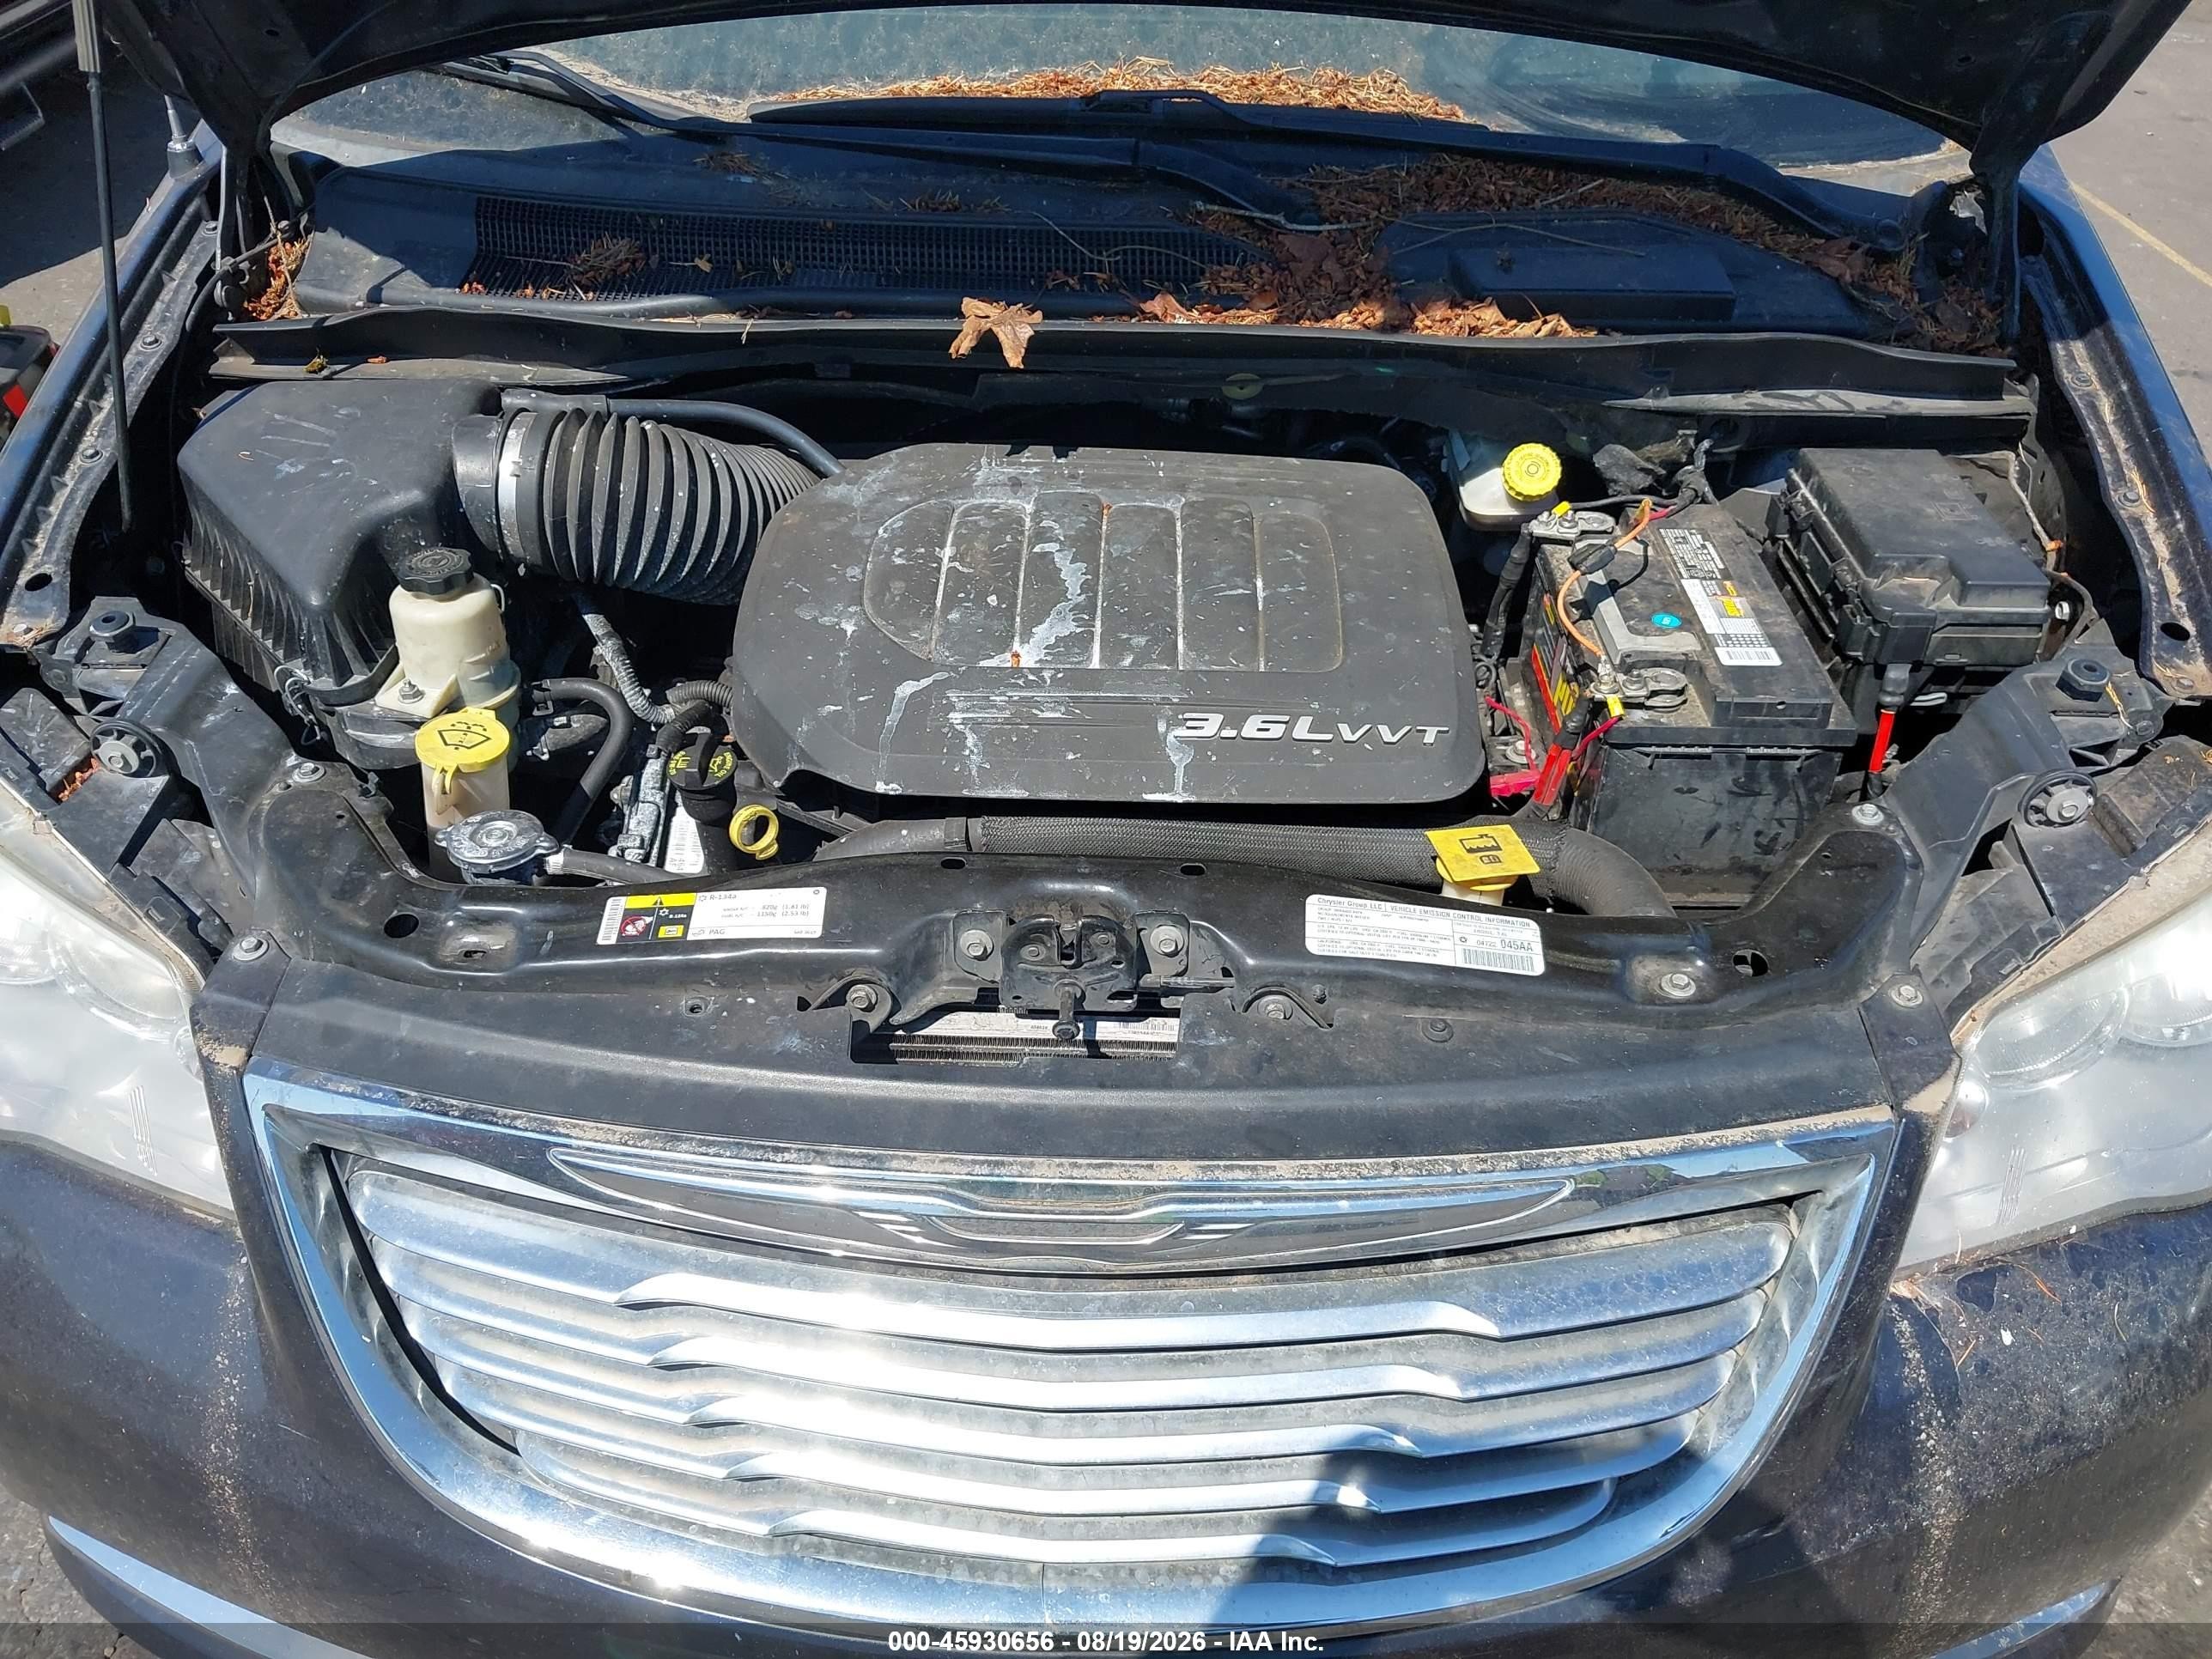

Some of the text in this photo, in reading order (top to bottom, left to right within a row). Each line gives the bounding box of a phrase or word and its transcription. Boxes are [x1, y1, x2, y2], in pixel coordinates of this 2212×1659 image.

[1173, 712, 1450, 745] 3.6L VVT
[714, 751, 733, 778] ENGINE OIL
[1317, 897, 1345, 906] Chrysler
[1347, 900, 1368, 908] Group
[1390, 905, 1417, 914] VEHICLE
[1419, 908, 1450, 917] EMISSION
[1452, 912, 1484, 921] CONTROL
[1485, 916, 1531, 927] INFORMATION
